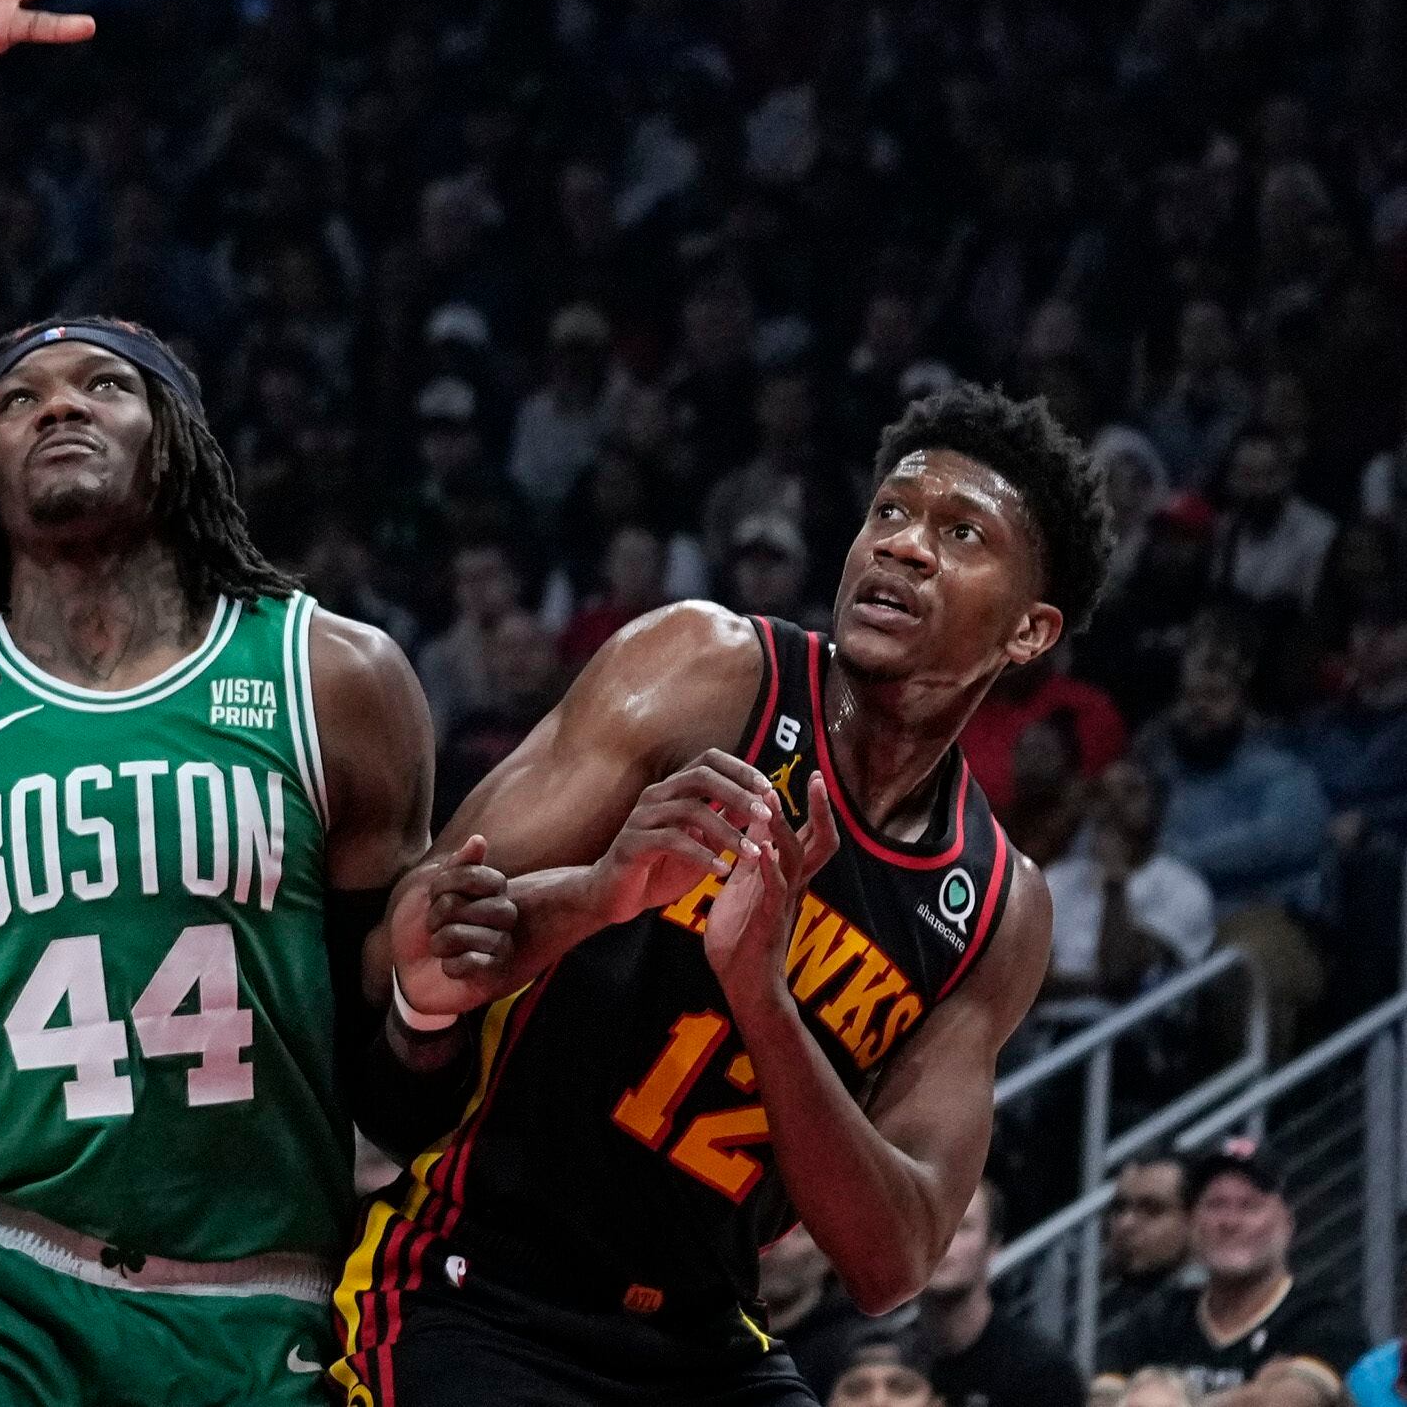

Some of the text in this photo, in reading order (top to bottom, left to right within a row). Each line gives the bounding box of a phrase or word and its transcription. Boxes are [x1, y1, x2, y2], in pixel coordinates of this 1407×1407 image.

[211, 678, 277, 709] VISTA
[210, 705, 277, 729] PRINT
[775, 714, 802, 752] 6
[916, 902, 967, 953] sharecare
[4, 924, 255, 1121] 44
[611, 1007, 770, 1205] 12
